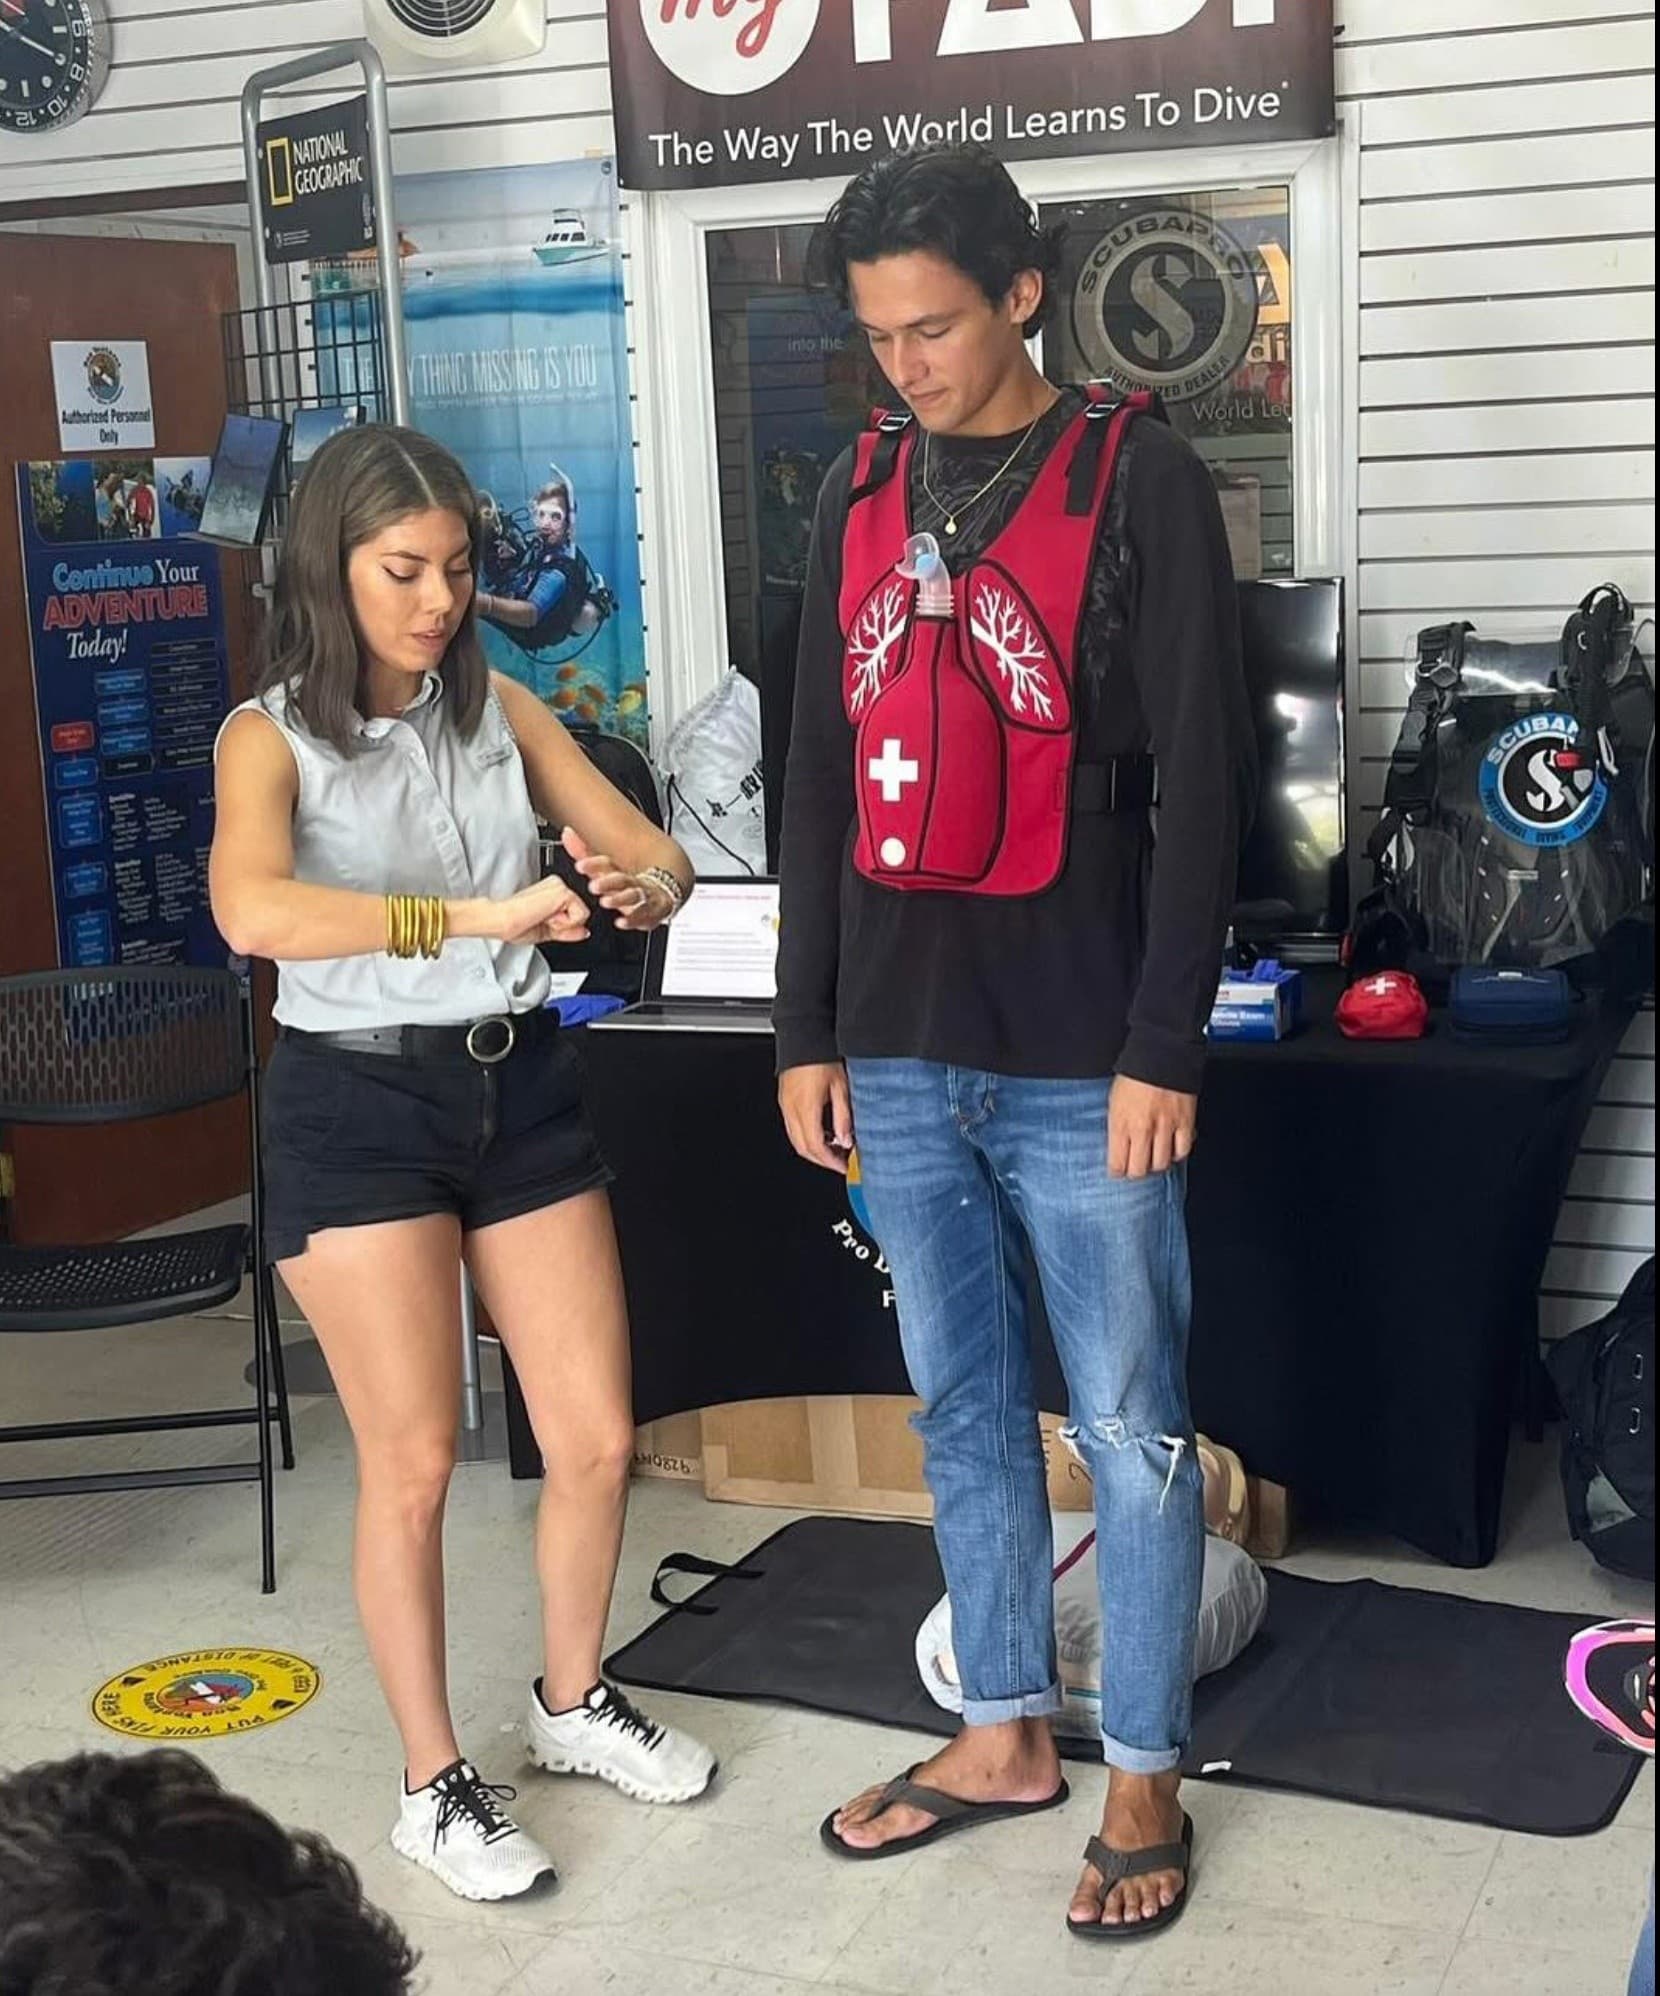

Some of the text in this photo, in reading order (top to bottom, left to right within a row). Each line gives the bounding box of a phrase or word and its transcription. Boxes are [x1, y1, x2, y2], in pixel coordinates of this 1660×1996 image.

[648, 86, 1281, 168] The Way The World Learns To Dive
[293, 130, 349, 165] NATIONAL
[295, 156, 364, 195] GEOGRAPHIC
[1081, 215, 1245, 295] SCUBAPRO
[421, 351, 468, 396] THING
[471, 347, 540, 394] MISSING
[543, 346, 562, 389] IS
[565, 343, 598, 387] YOU
[62, 406, 151, 424] Authorized Personnel
[1191, 398, 1254, 420] World
[100, 428, 118, 445] Only
[53, 558, 200, 591] Continue Your
[43, 584, 209, 631] ADVENTURE
[66, 628, 128, 663] Today!
[832, 1219, 870, 1260] Pro
[143, 1652, 237, 1672] DISTANCE
[160, 1725, 211, 1736] YOUR
[226, 1714, 265, 1730] PUT
